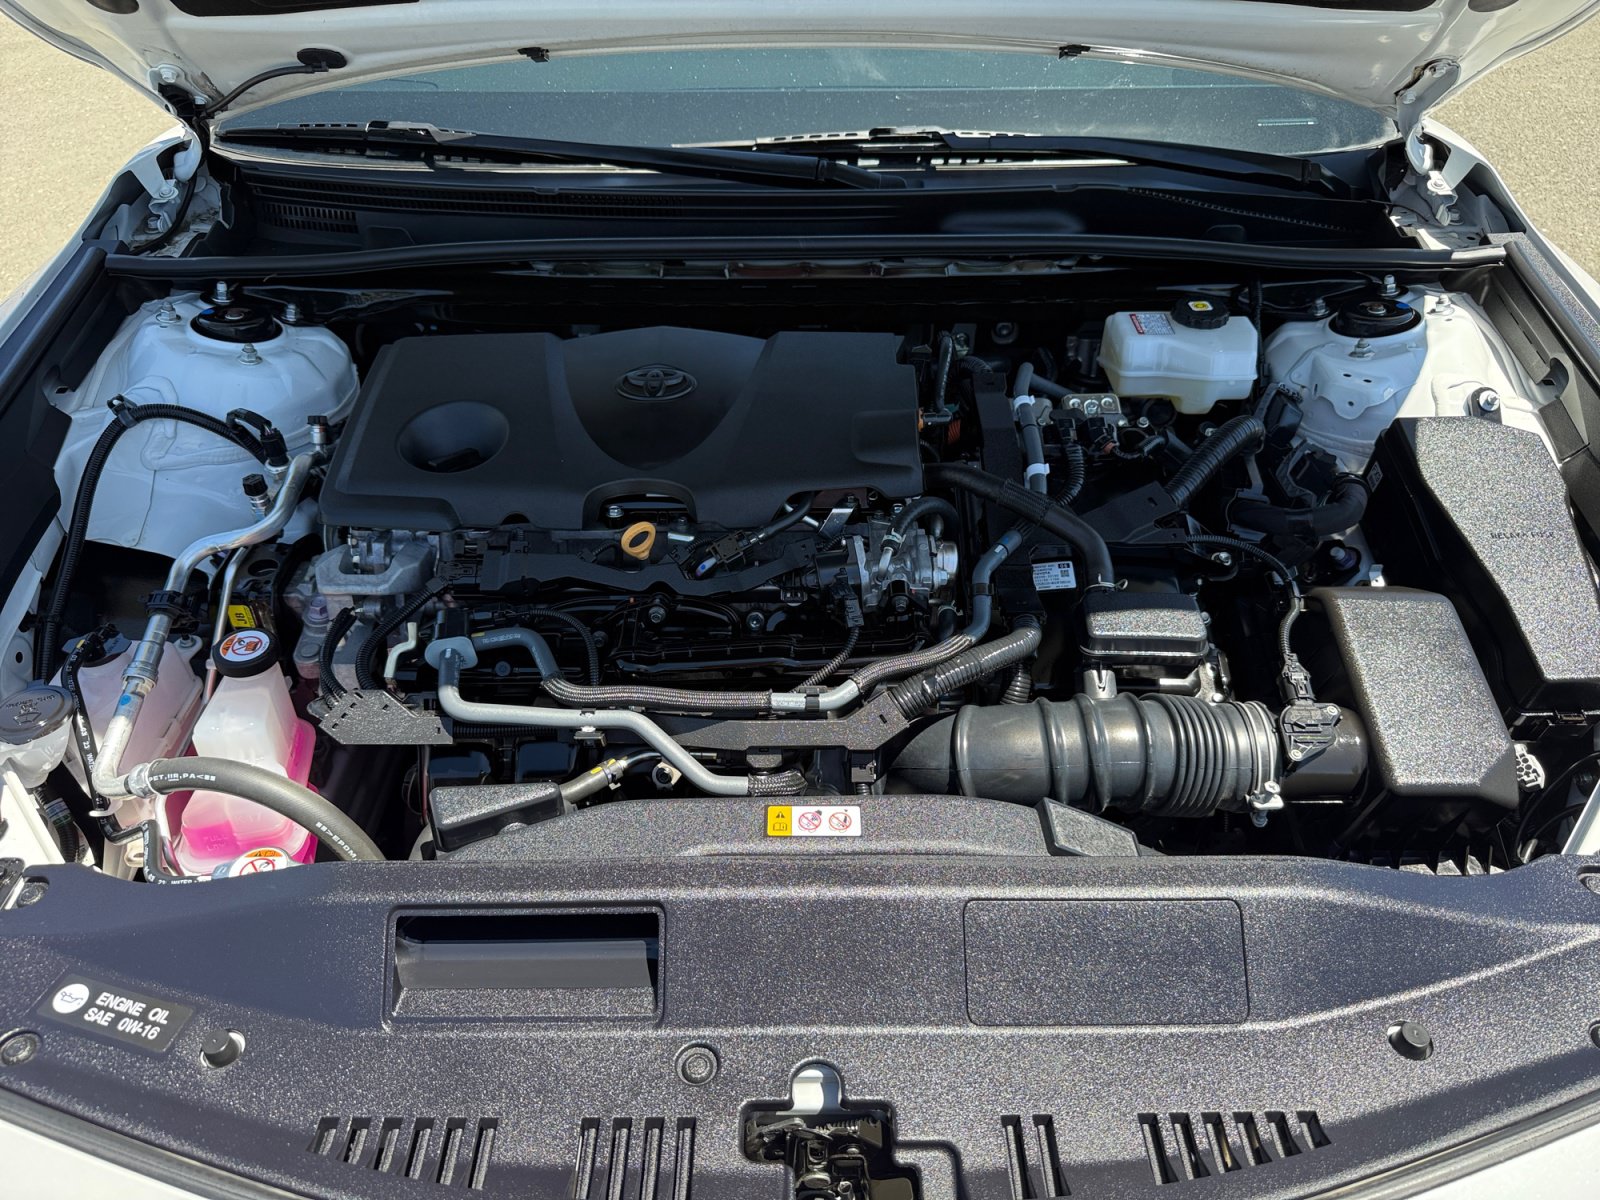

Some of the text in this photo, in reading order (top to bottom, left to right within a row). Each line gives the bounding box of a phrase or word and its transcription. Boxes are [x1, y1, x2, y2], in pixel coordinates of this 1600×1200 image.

[83, 1007, 160, 1040] SAE 0W-16
[95, 991, 170, 1025] ENGINE OIL
